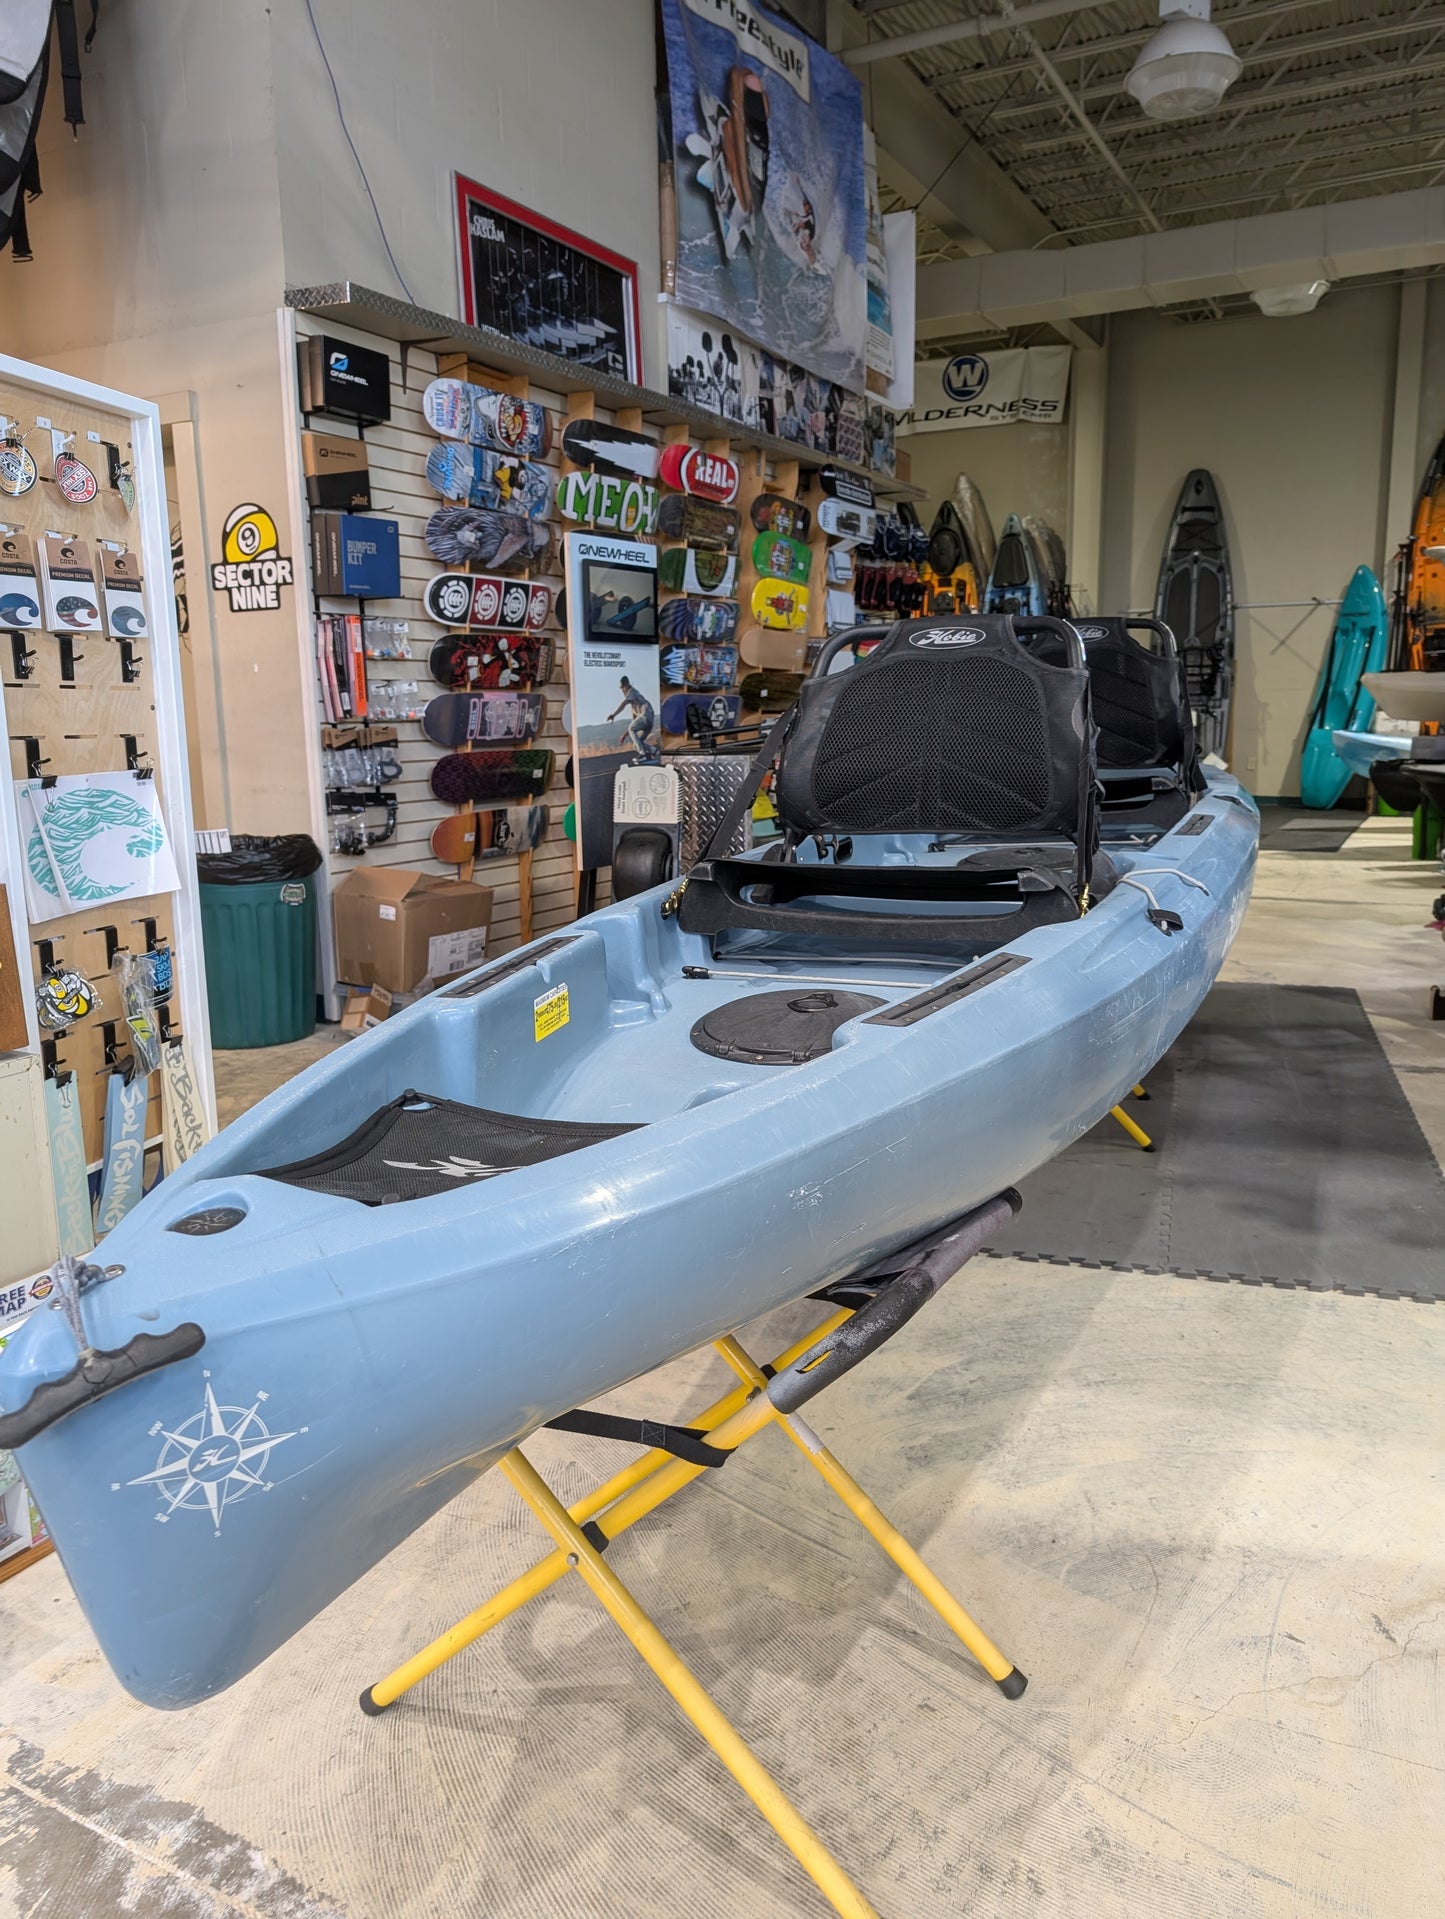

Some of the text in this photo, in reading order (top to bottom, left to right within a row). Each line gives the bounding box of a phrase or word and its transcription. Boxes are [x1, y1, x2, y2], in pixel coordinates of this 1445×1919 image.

[473, 214, 496, 230] CHRIS
[470, 223, 506, 243] HASLAM
[989, 411, 1052, 422] SYSEMS
[347, 540, 377, 555] BUMPER
[578, 543, 650, 564] ONEWHEEL
[347, 553, 363, 566] KIT
[213, 560, 293, 589] SECTOR
[231, 585, 279, 611] NINE
[917, 629, 977, 645] Hobie
[256, 1390, 271, 1402] NE
